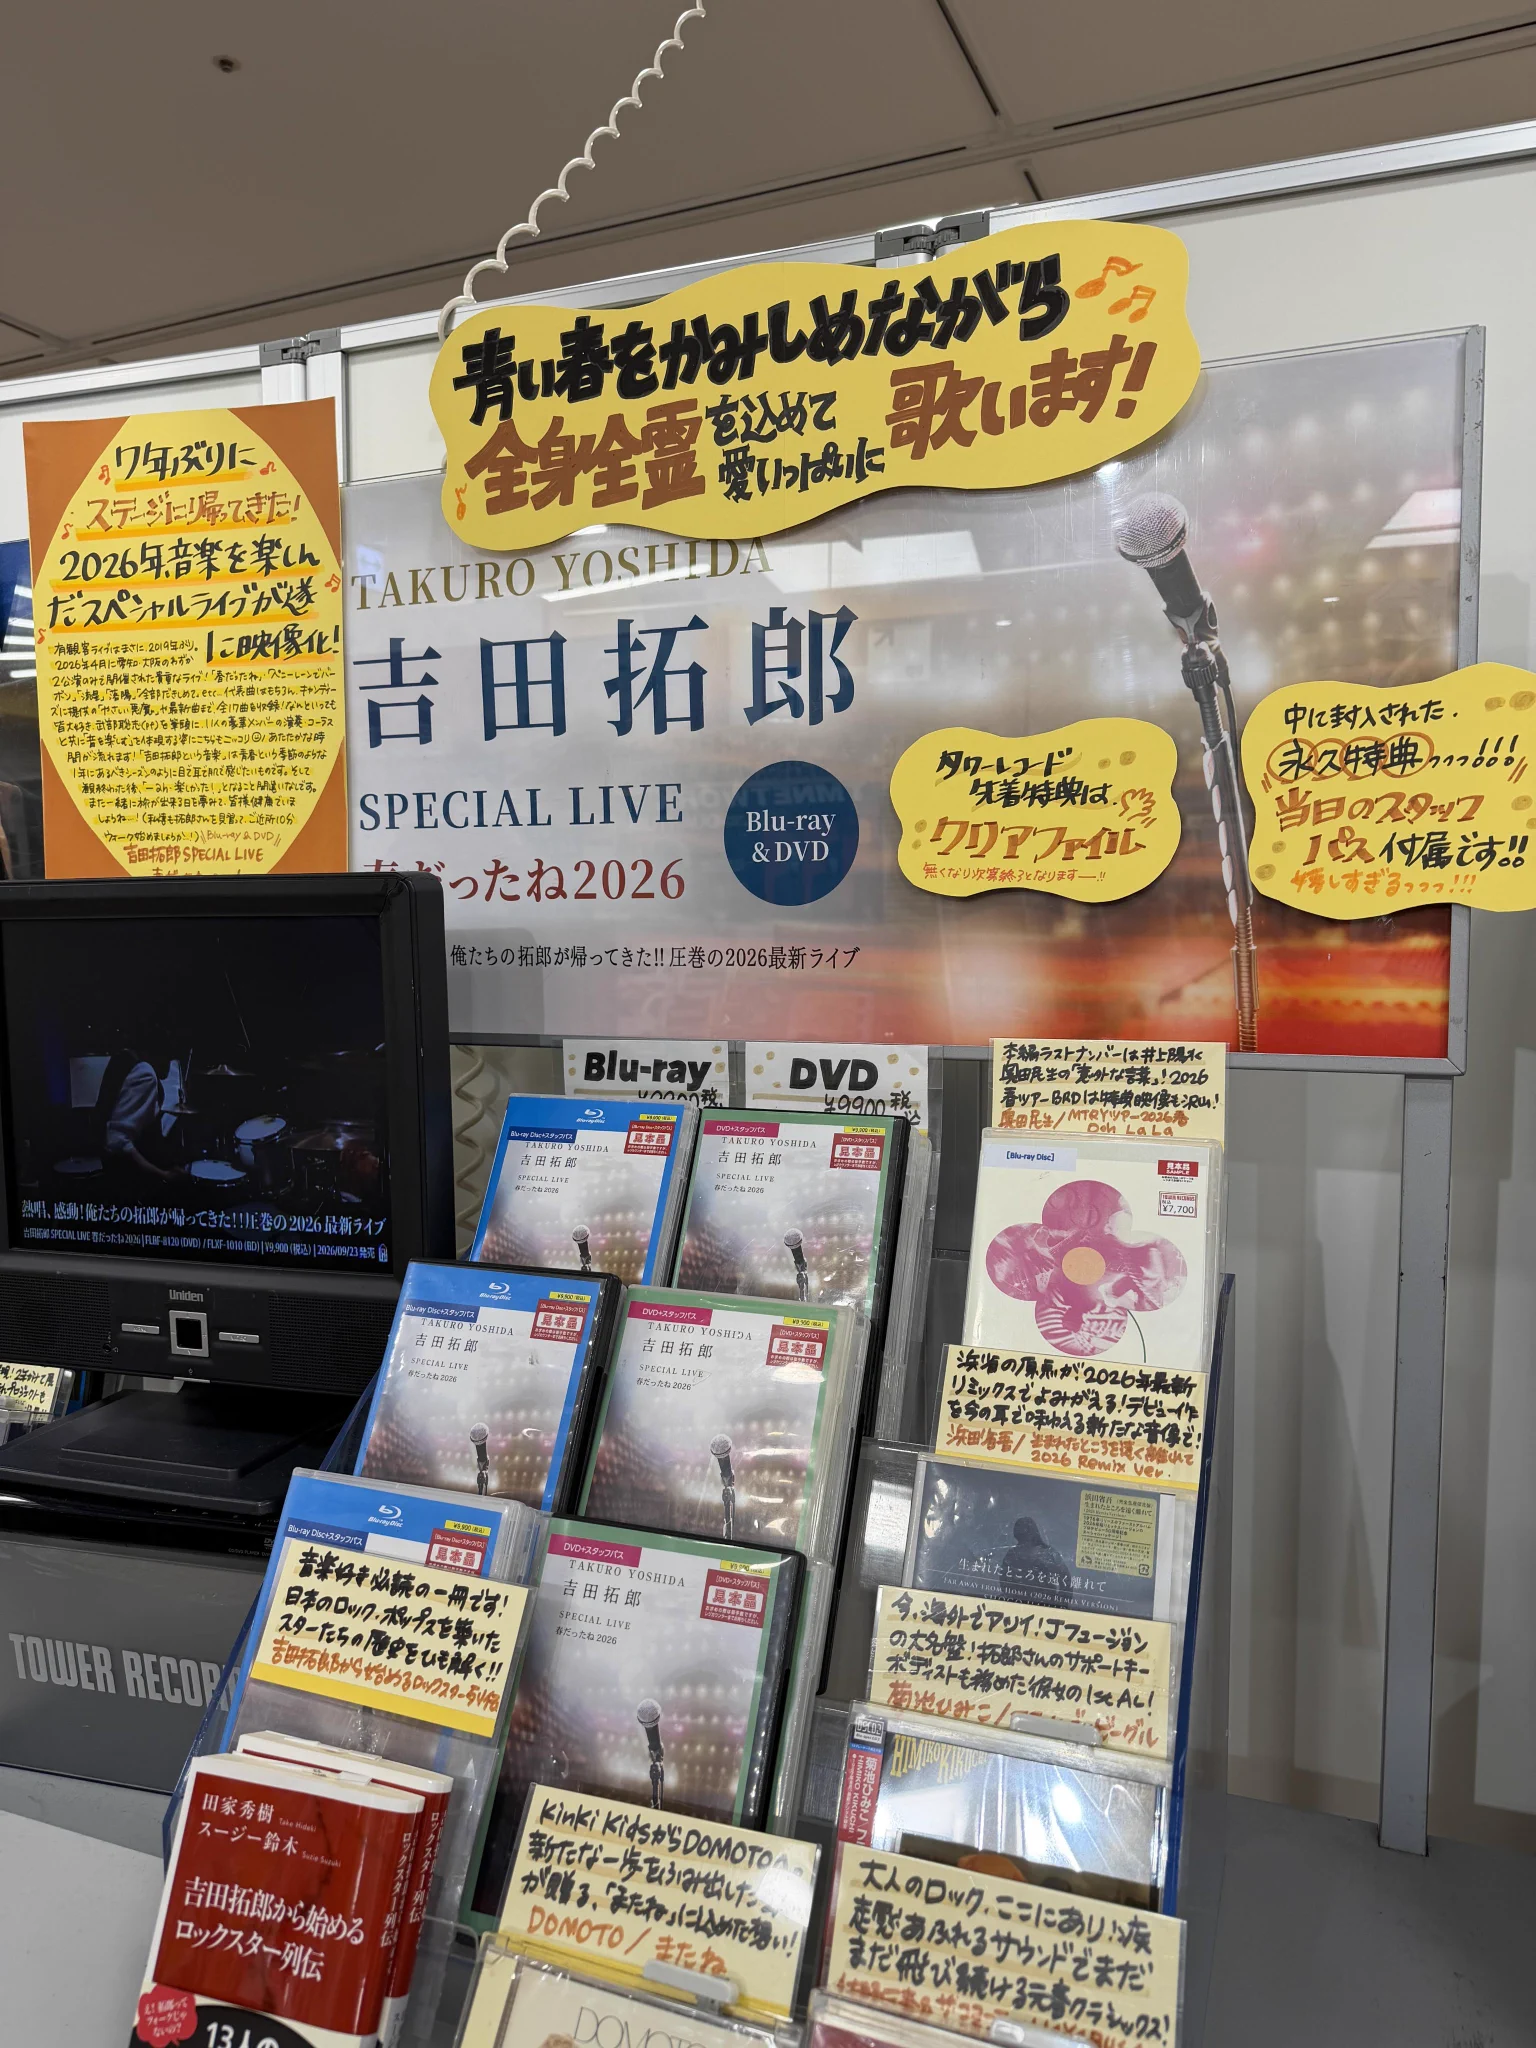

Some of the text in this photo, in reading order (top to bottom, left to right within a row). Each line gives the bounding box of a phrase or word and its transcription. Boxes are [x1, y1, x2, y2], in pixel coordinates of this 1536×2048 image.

[454, 253, 1071, 426] 青い春をかみしめながら
[889, 333, 1158, 460] 歌います!
[707, 389, 840, 448] を込めて
[116, 440, 257, 481] 7年ぶりに
[464, 397, 710, 517] 全身全霊
[719, 435, 886, 503] 愛いっぱいに
[352, 536, 773, 611] TAKURO YOSHIDA
[48, 576, 318, 628] だスペシャルライブが遂
[206, 622, 340, 663] に映像化!
[353, 604, 859, 749] 吉田拓郎
[936, 747, 1073, 780] タワーレコード
[360, 783, 683, 831] SPECIAL LIVE
[1275, 786, 1484, 832] 当日のスタッフ
[254, 832, 274, 842] DVD
[746, 809, 836, 837] Blu-ray
[123, 843, 264, 864] 吉田拓郎 SPECIAL LIVE
[752, 840, 829, 862] & DVD
[930, 816, 1147, 863] クリアファイル
[669, 945, 860, 971] 圧巻の2026最新ライブ
[584, 1050, 712, 1092] Blu-ray
[789, 1057, 879, 1091] DVD
[510, 1130, 529, 1139] Blu-ray
[716, 1124, 766, 1134] DVD+スタッフパス
[721, 1136, 817, 1149] TAKURO YOSHIDA
[520, 1153, 578, 1169] 吉田拓郎
[525, 1141, 609, 1153] TAKURO YOSHIDA
[718, 1150, 782, 1166] 吉田拓郎
[838, 1146, 876, 1159] 見本品
[517, 1174, 549, 1182] SPECIAL
[716, 1172, 775, 1183] SPECIAL LIVE
[1166, 1162, 1191, 1170] 見本品
[1162, 1204, 1194, 1214] ¥7,700
[51, 1229, 76, 1240] SPECIAL
[77, 1230, 90, 1241] LIVE
[317, 1245, 358, 1257] 2026/09/23
[359, 1246, 375, 1259] 発売
[169, 1289, 204, 1302] Uniden
[406, 1304, 474, 1318] Blu-ray Disc+スタッフパス
[642, 1308, 697, 1320] DVD+スタッフパス
[421, 1318, 514, 1336] TAKURO YOSHIDA
[648, 1322, 752, 1341] TAKURO YOSHIDA
[415, 1332, 479, 1353] 吉田拓郎
[642, 1338, 713, 1359] 吉田拓郎
[777, 1340, 817, 1356] 見本品
[411, 1357, 469, 1371] SPECIAL LIVE
[639, 1363, 704, 1378] SPECIAL LIVE
[1031, 1452, 1126, 1473] 2026 Remix
[288, 1524, 363, 1546] Blu-ray Disc+スタッフパス
[435, 1547, 475, 1567] 見本品
[563, 1541, 624, 1560] DVD+スタッフパス
[568, 1559, 686, 1588] TAKURO YOSHIDA
[958, 1558, 1107, 1592] 生まれたところを遠く離れて
[563, 1579, 642, 1608] 吉田拓郎
[713, 1588, 756, 1609] 見本品
[559, 1610, 631, 1631] SPECIAL LIVE
[9, 1633, 116, 1694] TOWER
[890, 1734, 941, 1778] HIMIKO
[854, 1755, 865, 1790] HIMIKO
[202, 1792, 275, 1824] 田家秀樹
[295, 1819, 317, 1833] Hideki
[848, 1792, 860, 1834] KIKUCHI
[198, 1822, 341, 1868] スージー鈴木 Suzie Suzuki
[409, 1812, 440, 1925] ロックスター列伝
[381, 1832, 412, 1949] ロックスター列伝
[185, 1876, 364, 1946] 吉田拓郎から始める
[175, 1920, 325, 1982] ロックスター列伝
[655, 1934, 728, 1976] またね
[849, 1895, 1154, 1992] 走感あふれるサウンドでまだ
